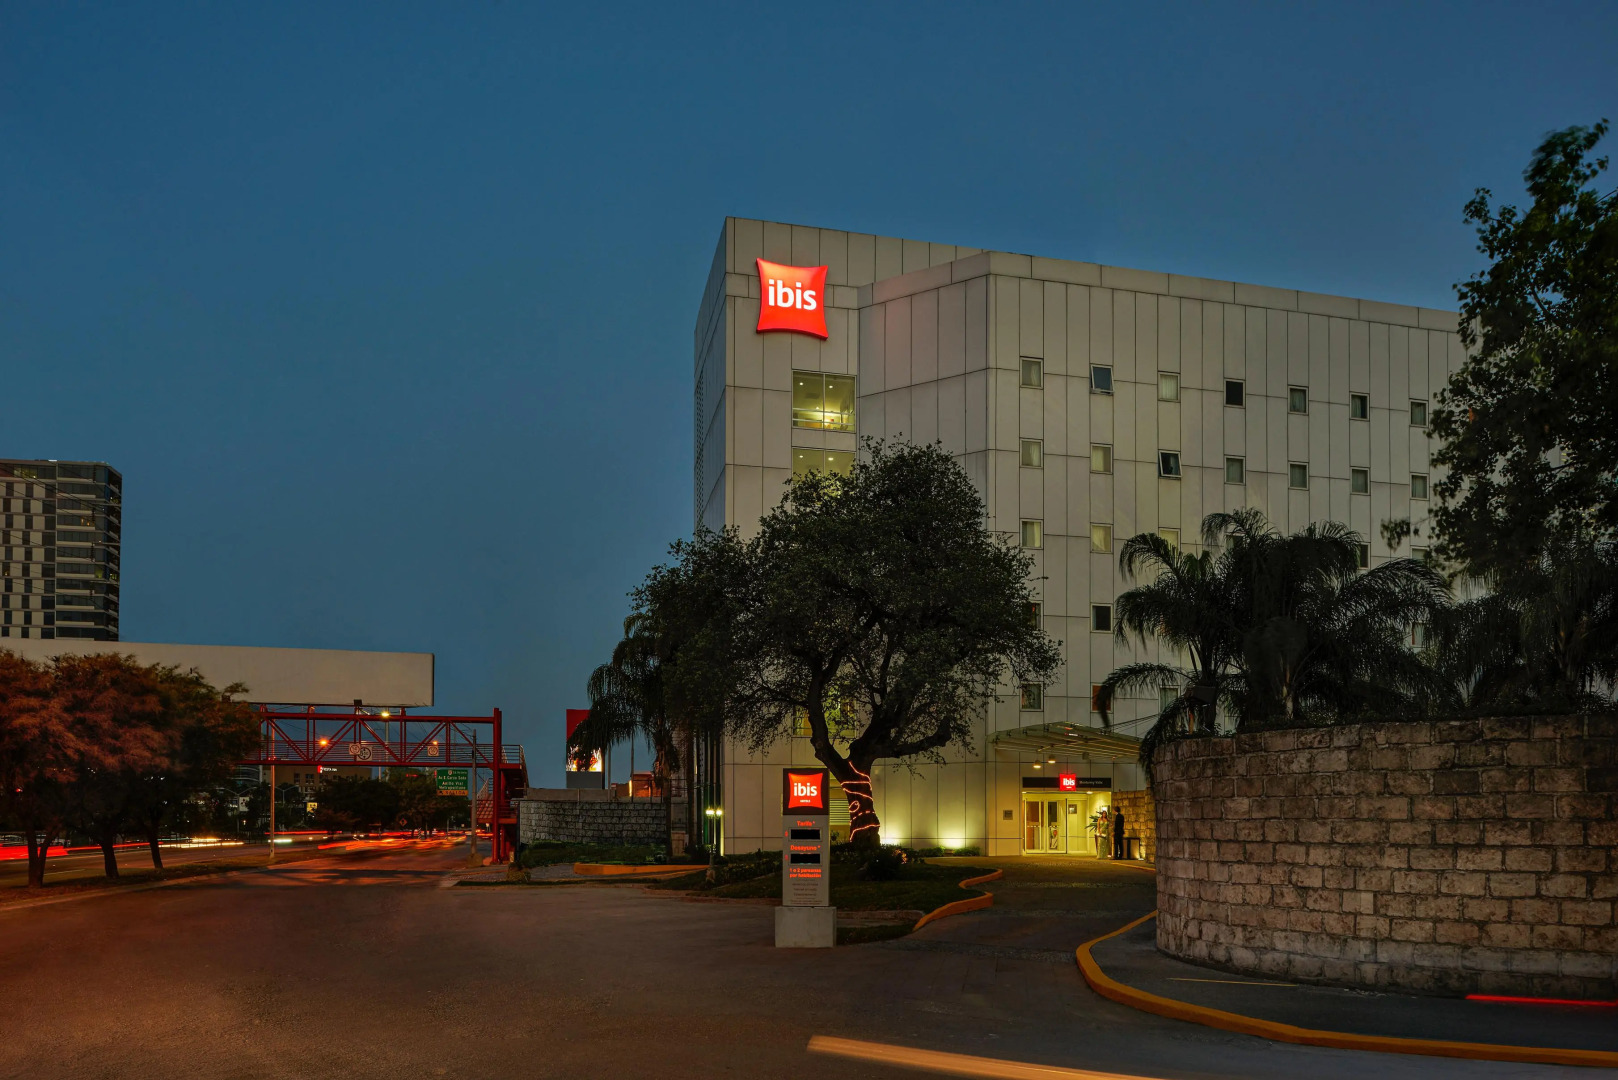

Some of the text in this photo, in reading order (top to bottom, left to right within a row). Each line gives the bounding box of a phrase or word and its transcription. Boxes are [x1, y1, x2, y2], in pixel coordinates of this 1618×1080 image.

[768, 279, 817, 310] ibis
[793, 782, 818, 797] ibis
[1063, 778, 1075, 786] ibis
